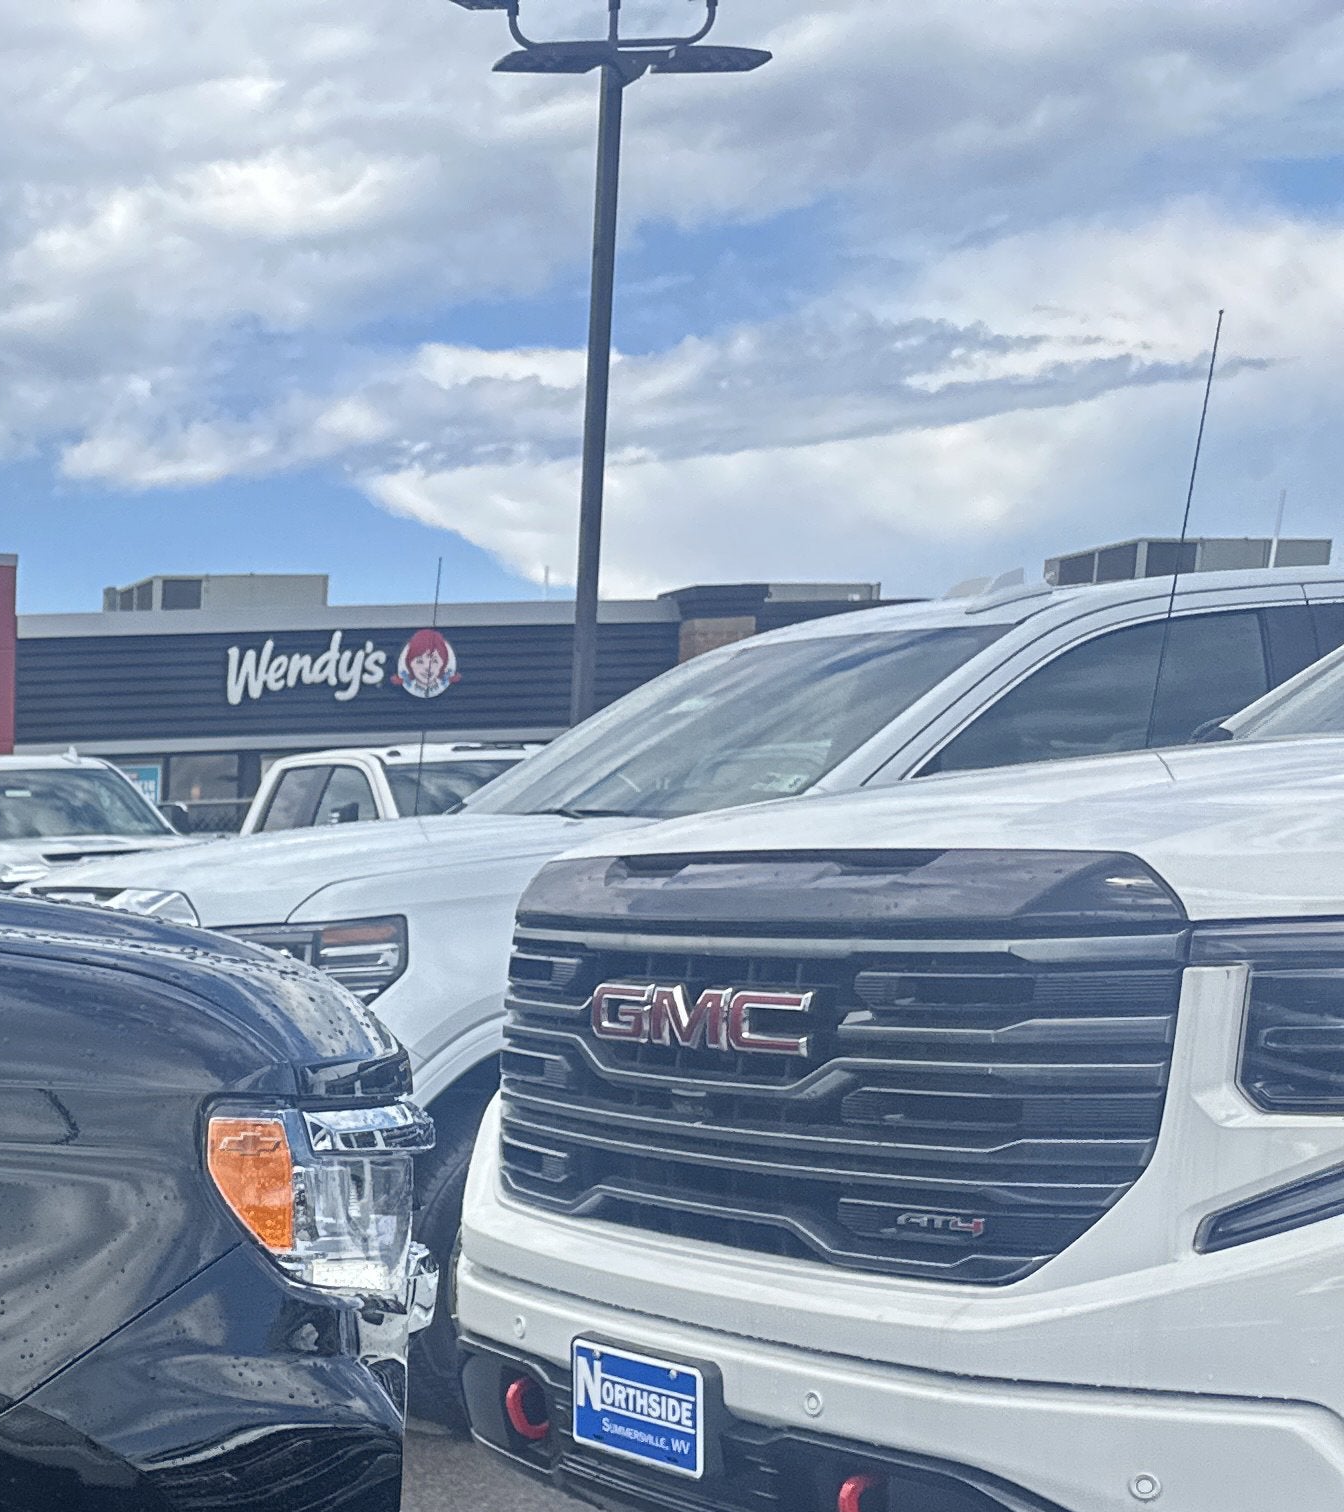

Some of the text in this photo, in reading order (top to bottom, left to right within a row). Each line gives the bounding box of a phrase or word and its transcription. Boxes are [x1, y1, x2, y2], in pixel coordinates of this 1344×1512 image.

[226, 630, 387, 705] Wendy's
[592, 982, 814, 1058] GMC
[897, 1212, 986, 1238] AT4
[576, 1356, 694, 1427] NORTHSIDE
[671, 1438, 691, 1455] WV
